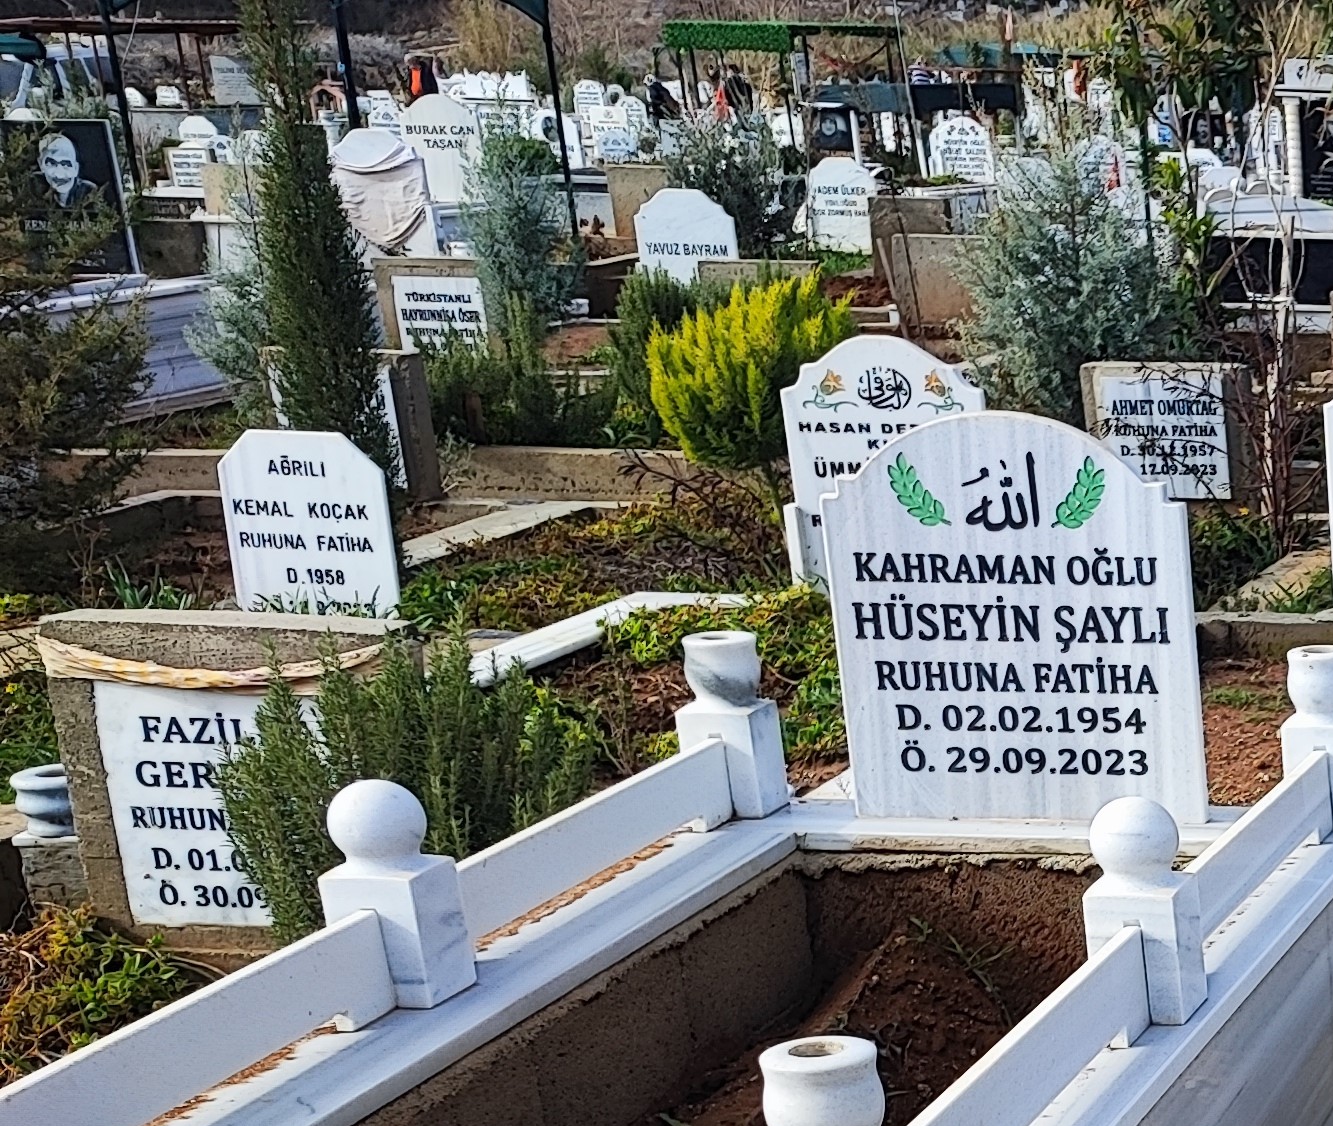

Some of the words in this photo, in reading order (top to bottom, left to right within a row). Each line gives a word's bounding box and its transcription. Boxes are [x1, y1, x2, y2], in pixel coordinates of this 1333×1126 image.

[405, 125, 448, 135] BURAK
[645, 242, 681, 255] YAVUZ
[683, 244, 729, 257] BAYRAM
[1111, 399, 1155, 416] AHMET
[798, 421, 872, 434] HASAN
[1171, 422, 1218, 437] FATİHA
[232, 498, 294, 518] KEMAL
[306, 501, 369, 523] KOÇAK
[239, 531, 307, 550] RUHUNA
[316, 531, 374, 553] FATİHA
[853, 551, 1057, 586] KAHRAMAN
[1066, 547, 1158, 587] OĞLU
[852, 594, 1041, 644] HÜSEYİN
[1054, 603, 1171, 654] ŞAYLI
[875, 659, 1026, 694] RUHUNA
[1034, 655, 1159, 696] FATİHA
[896, 703, 932, 732] D.
[941, 704, 1147, 736] 02.02.1954
[900, 740, 936, 774] Ö.
[946, 746, 1149, 777] 29.09.2023
